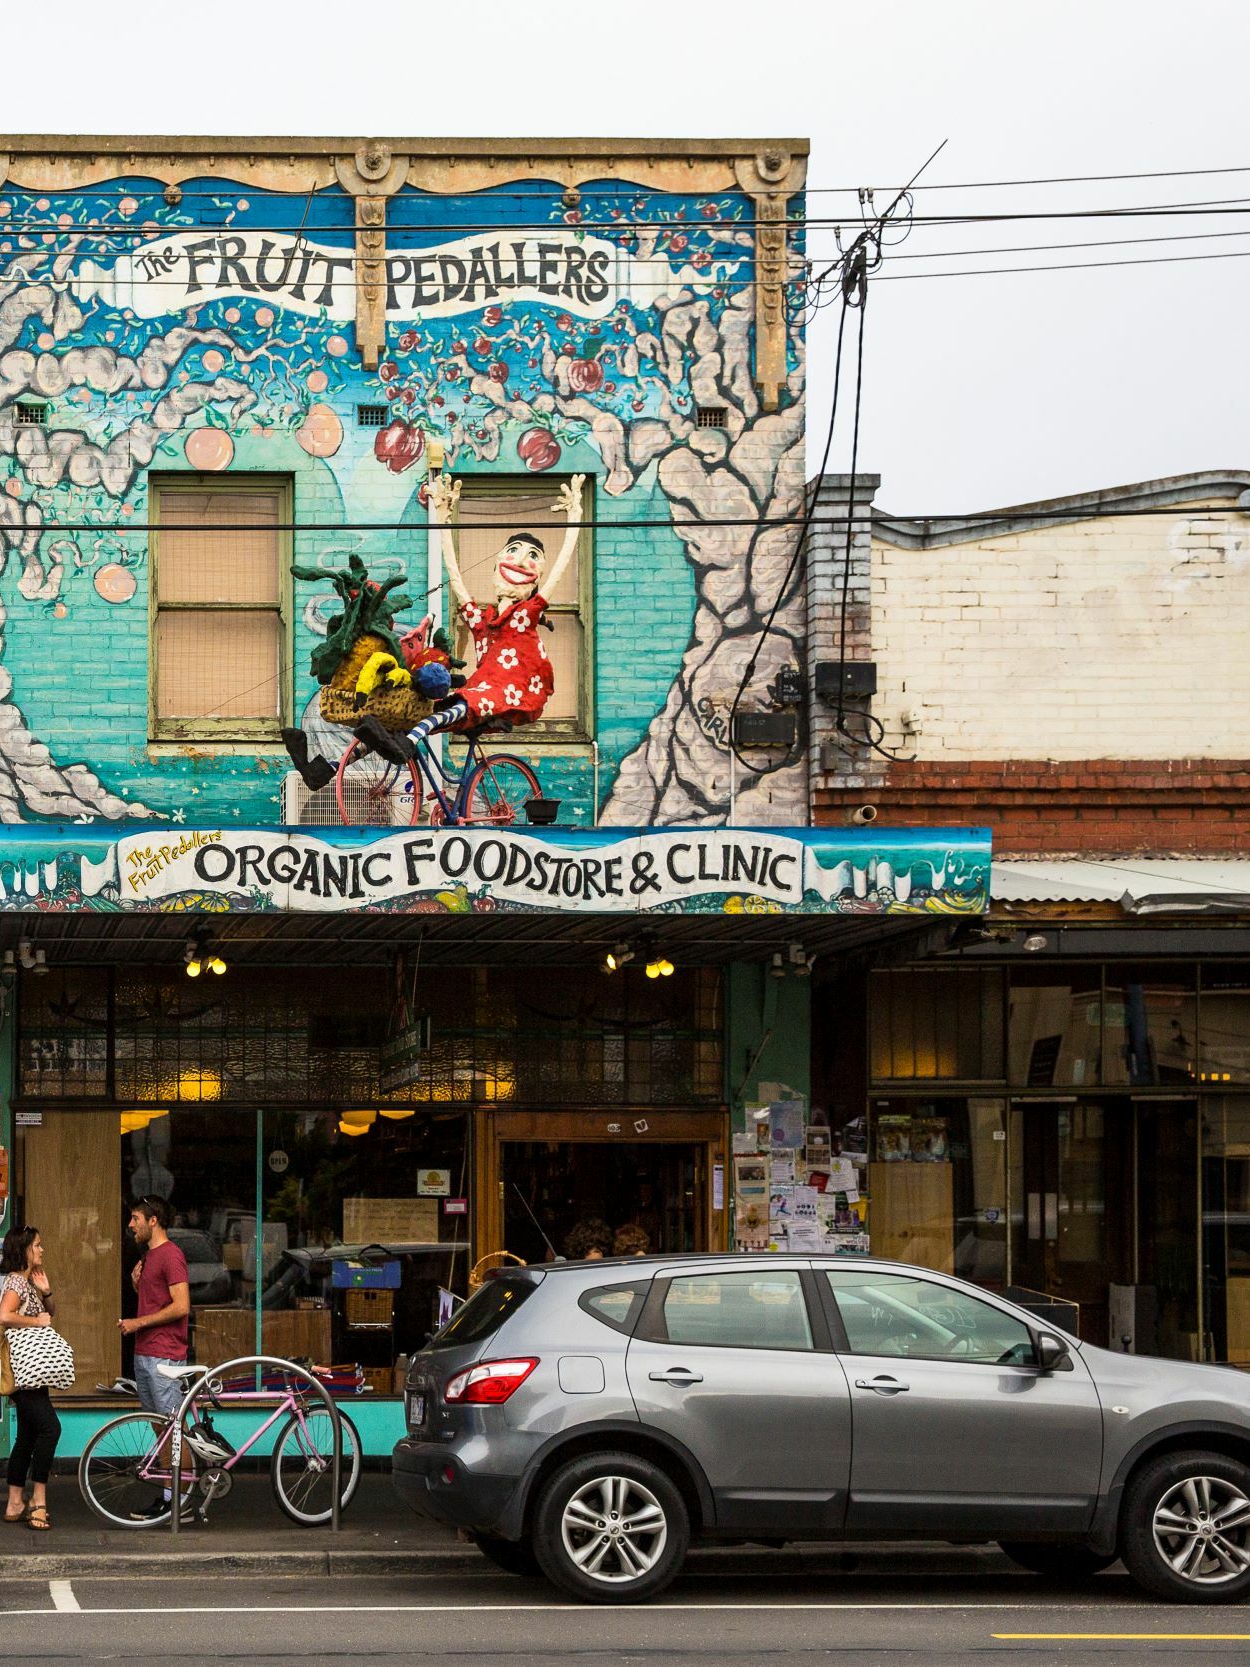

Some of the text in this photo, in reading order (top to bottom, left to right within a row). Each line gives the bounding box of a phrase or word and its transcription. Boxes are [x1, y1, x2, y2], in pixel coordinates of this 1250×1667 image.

[133, 235, 612, 309] The FRUIT PEDALLERS
[125, 846, 153, 868] The
[194, 835, 797, 900] ORGANIC FOODSTORE & CLINIC
